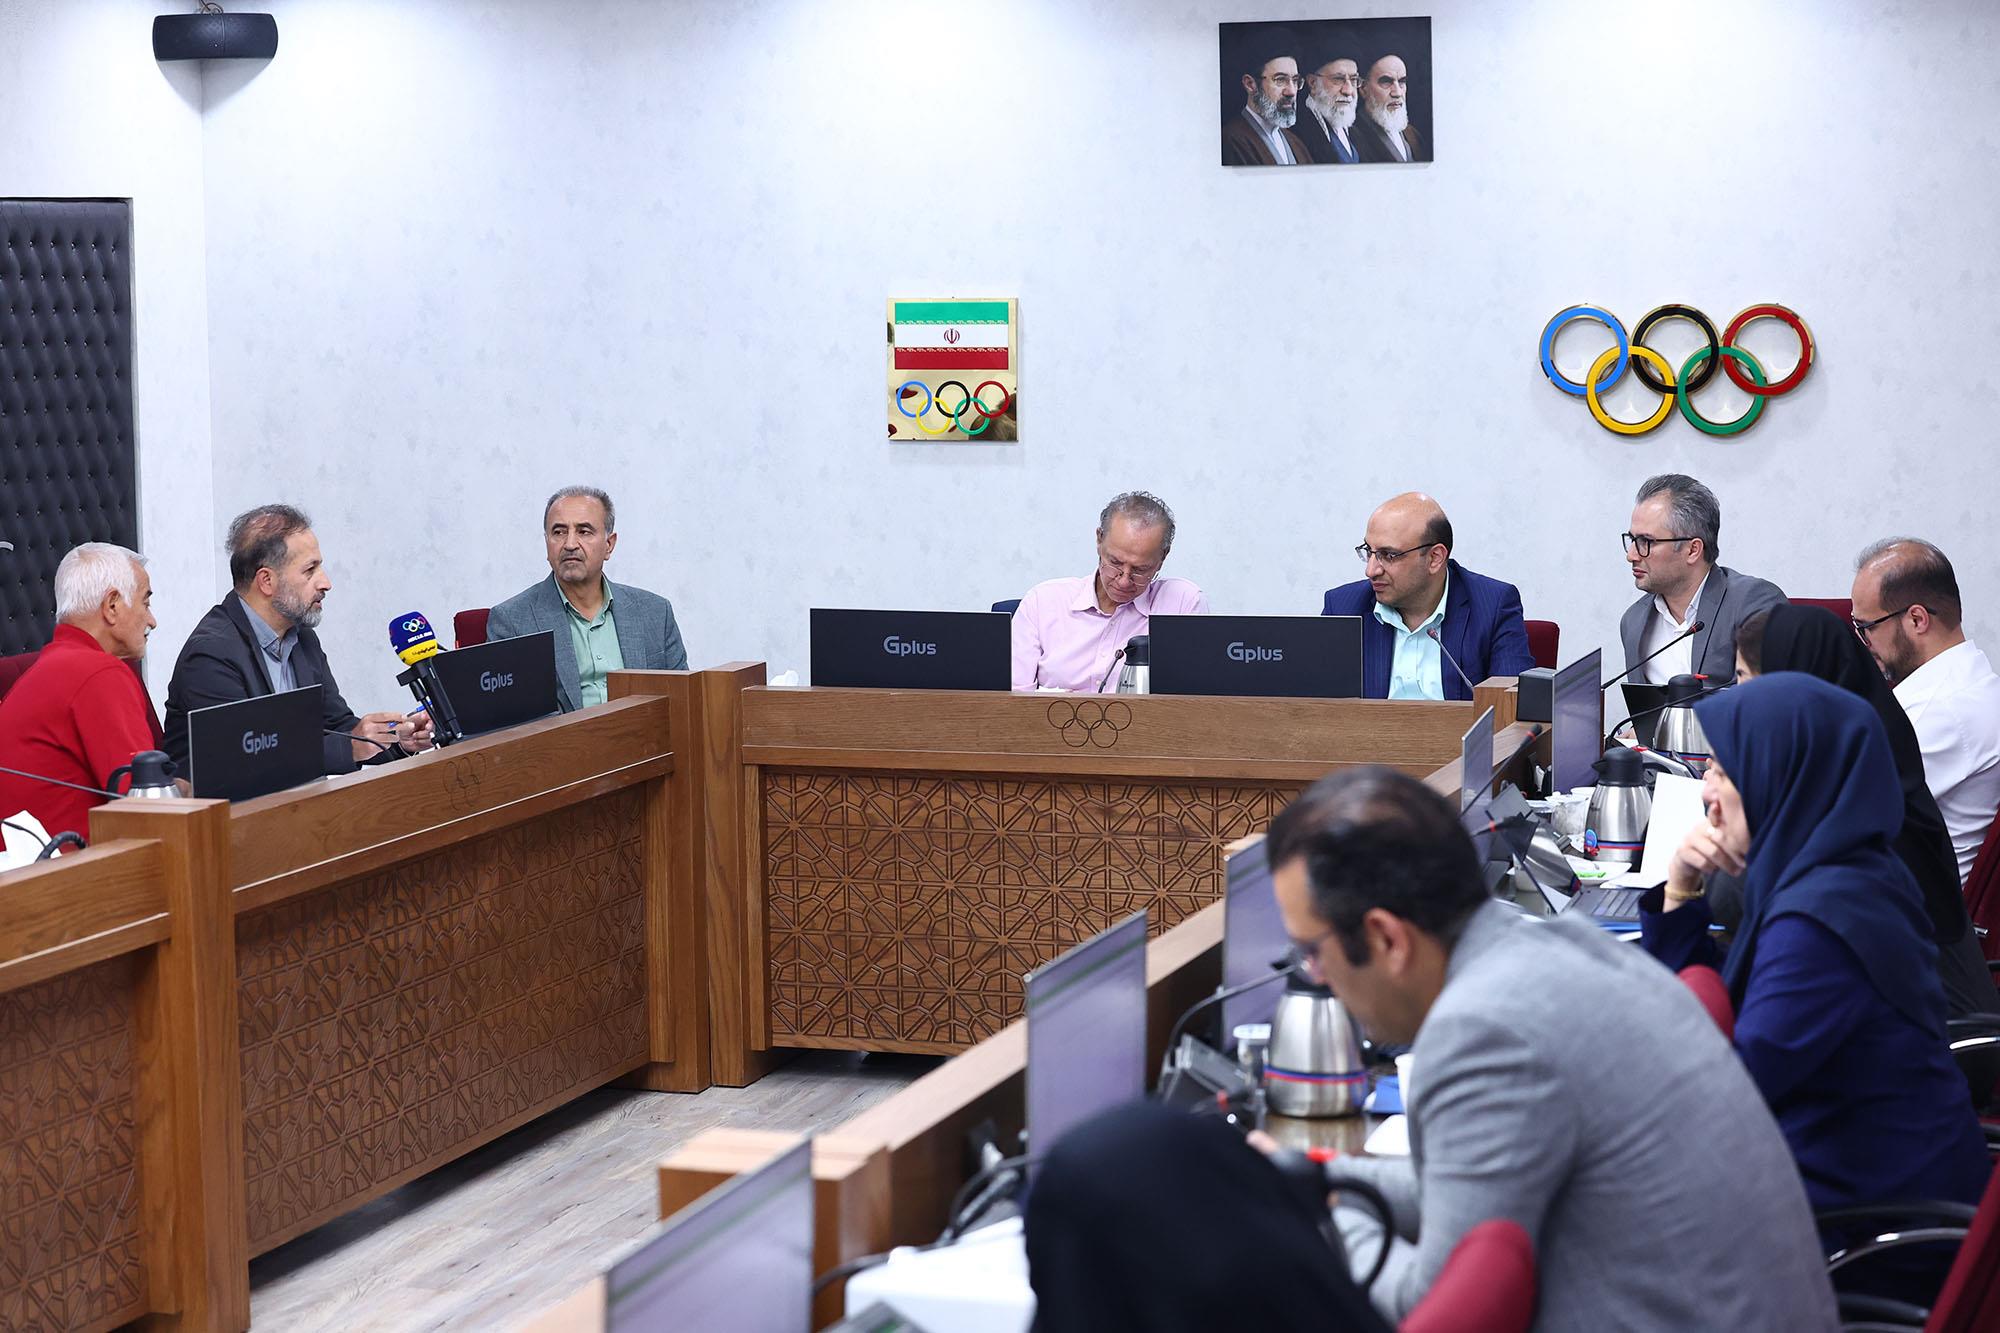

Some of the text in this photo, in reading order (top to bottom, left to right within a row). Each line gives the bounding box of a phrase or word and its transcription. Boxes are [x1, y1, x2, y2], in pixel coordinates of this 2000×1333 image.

[883, 635, 937, 657] Gplus
[1226, 641, 1284, 664] Gplus
[480, 671, 513, 692] Gplus
[243, 730, 278, 755] Gplus
